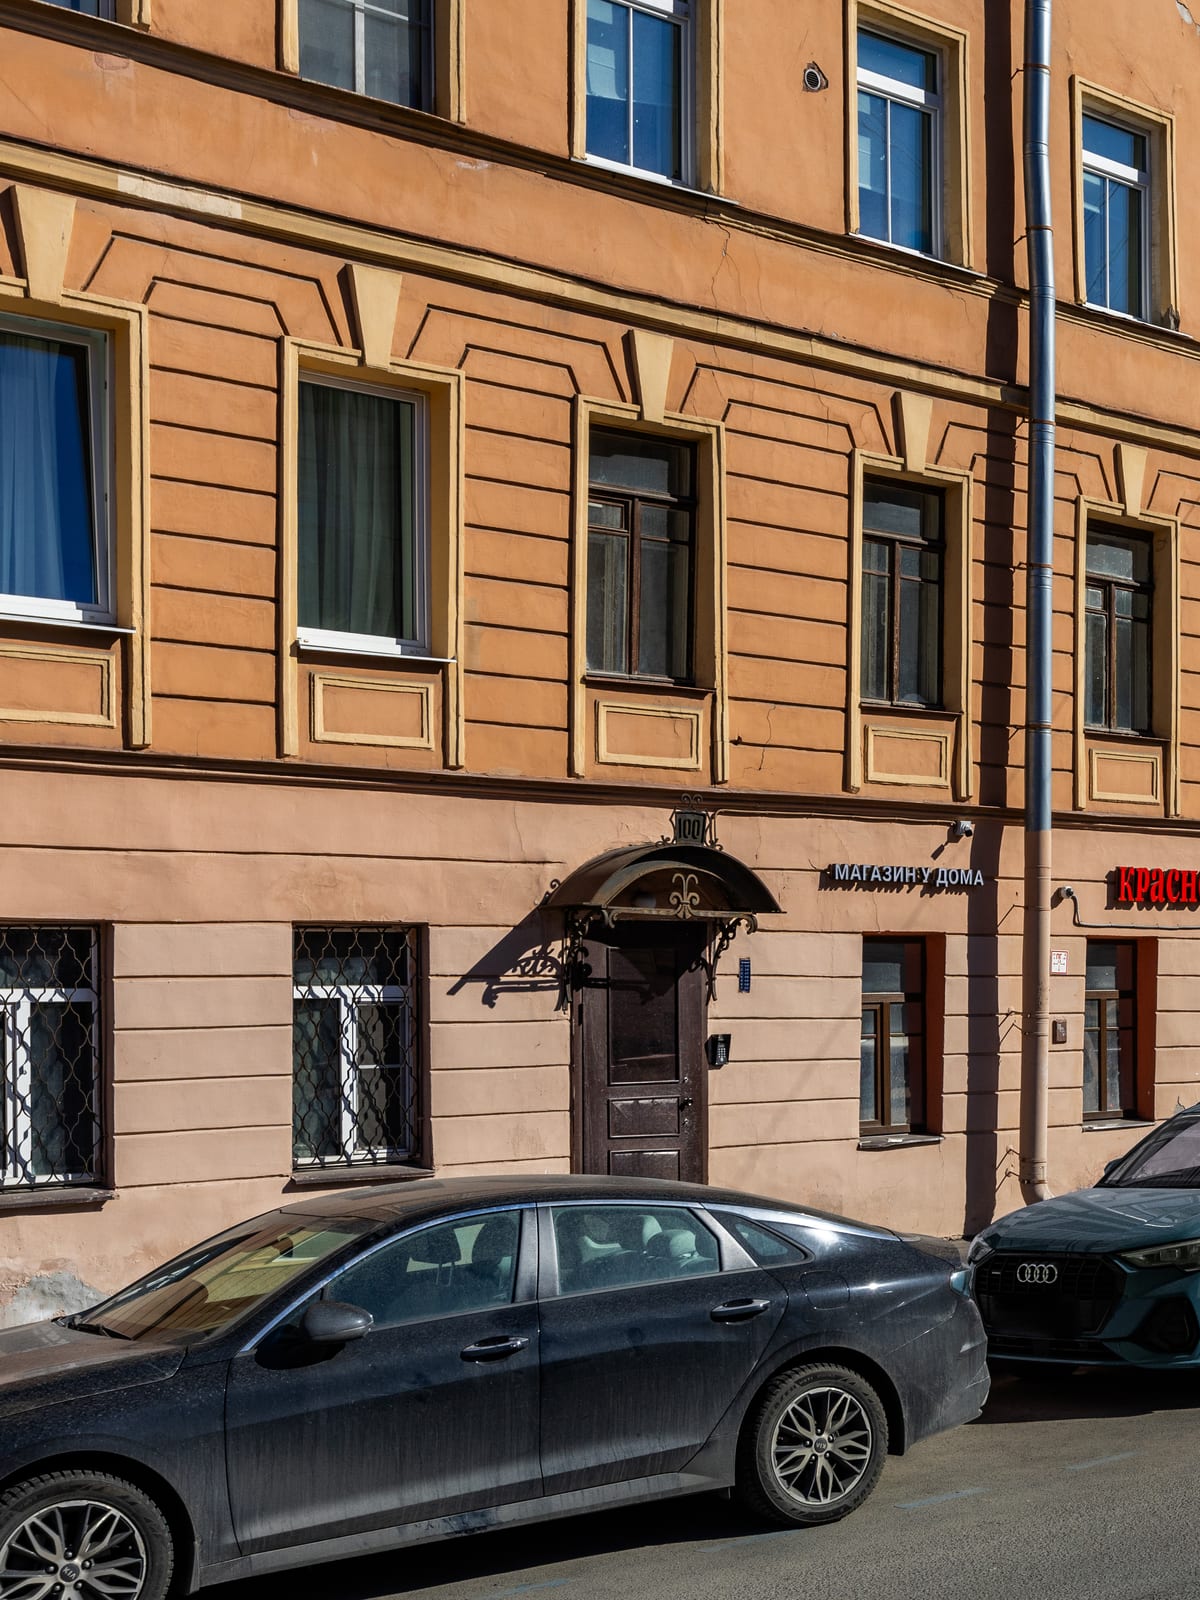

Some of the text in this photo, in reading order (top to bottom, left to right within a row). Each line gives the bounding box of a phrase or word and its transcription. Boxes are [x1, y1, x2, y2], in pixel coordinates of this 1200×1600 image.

[835, 863, 984, 888] МАГАЗИН У ДОМА
[62, 1566, 77, 1580] KIA
